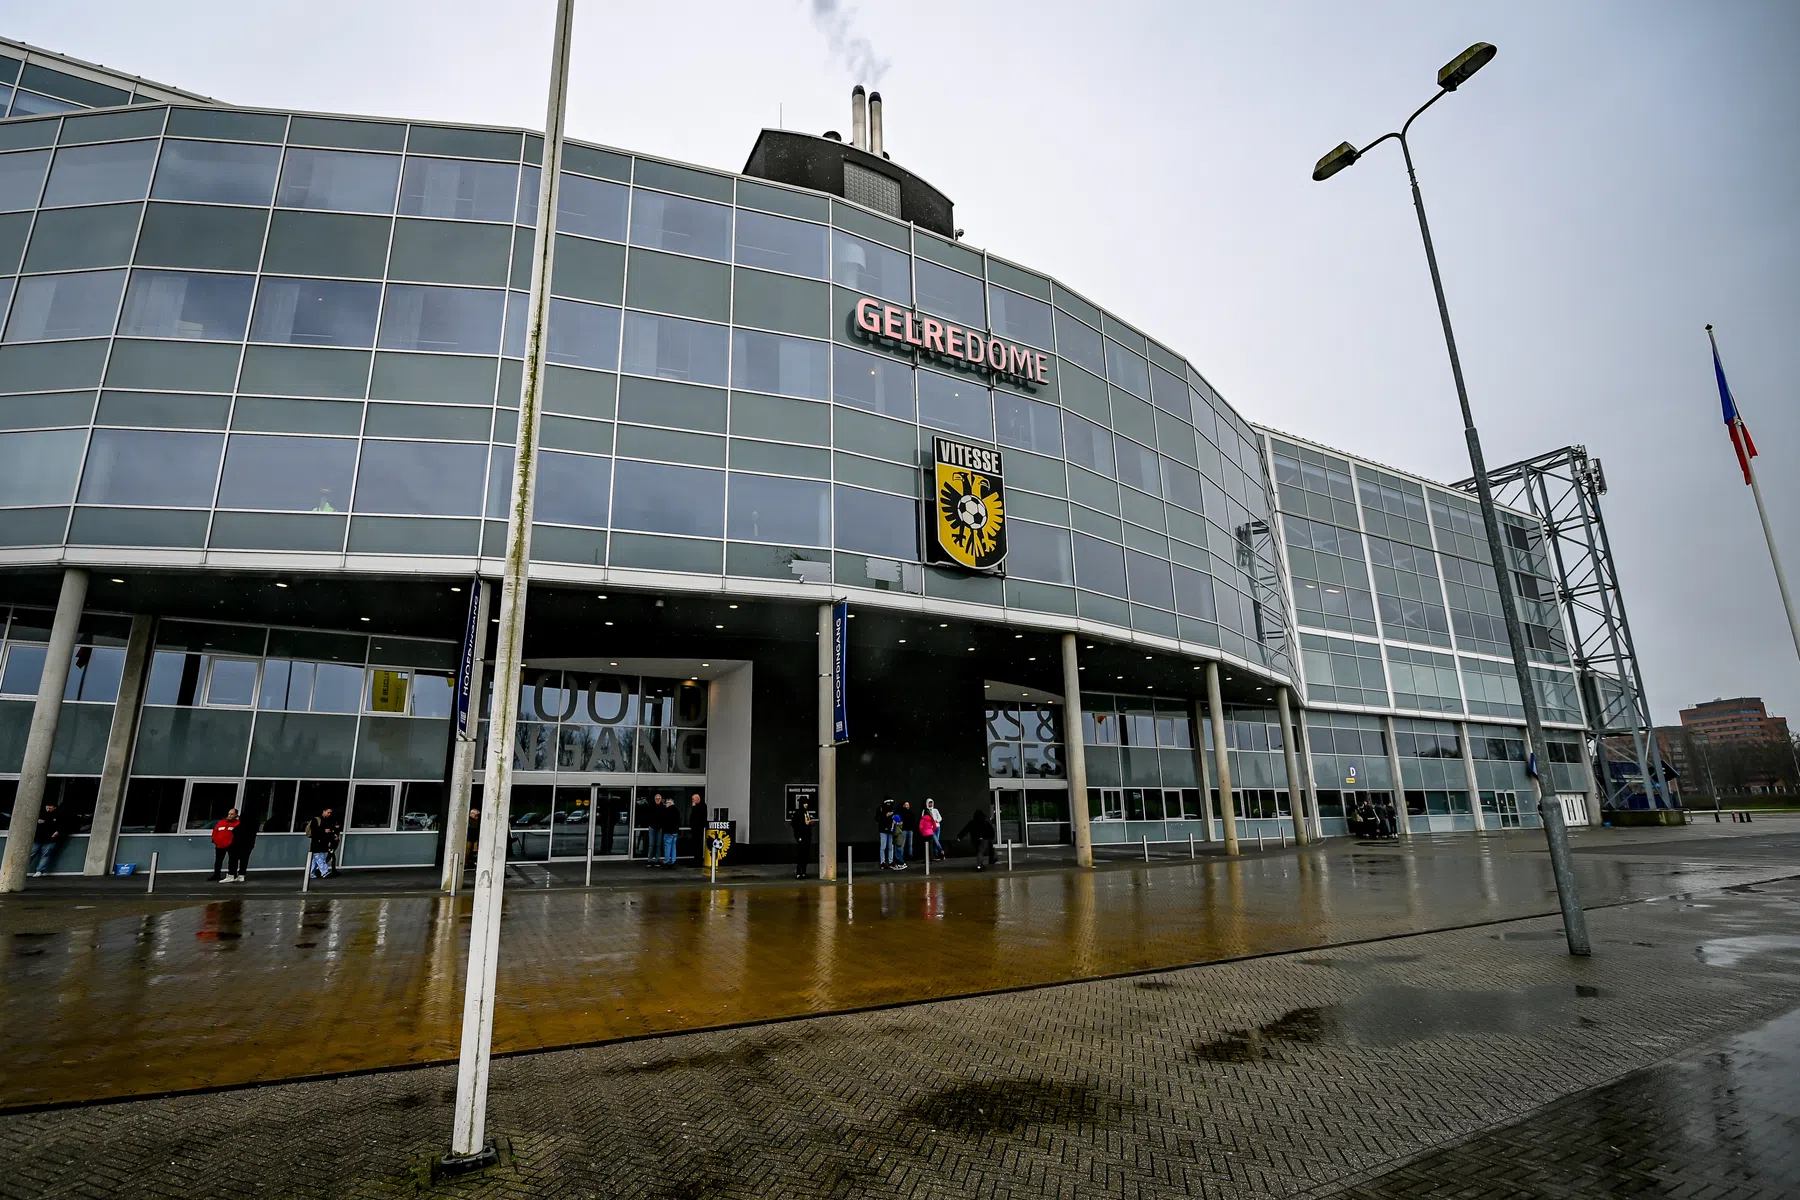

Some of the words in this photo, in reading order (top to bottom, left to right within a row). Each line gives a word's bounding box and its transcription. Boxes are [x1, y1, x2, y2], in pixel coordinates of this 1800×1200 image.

[854, 297, 1050, 385] GELREDOME
[940, 440, 999, 474] VITESSE
[462, 595, 479, 696] HOOFDINGANG
[988, 742, 1065, 779] GES
[1349, 767, 1356, 776] D
[709, 821, 730, 830] VITESSE
